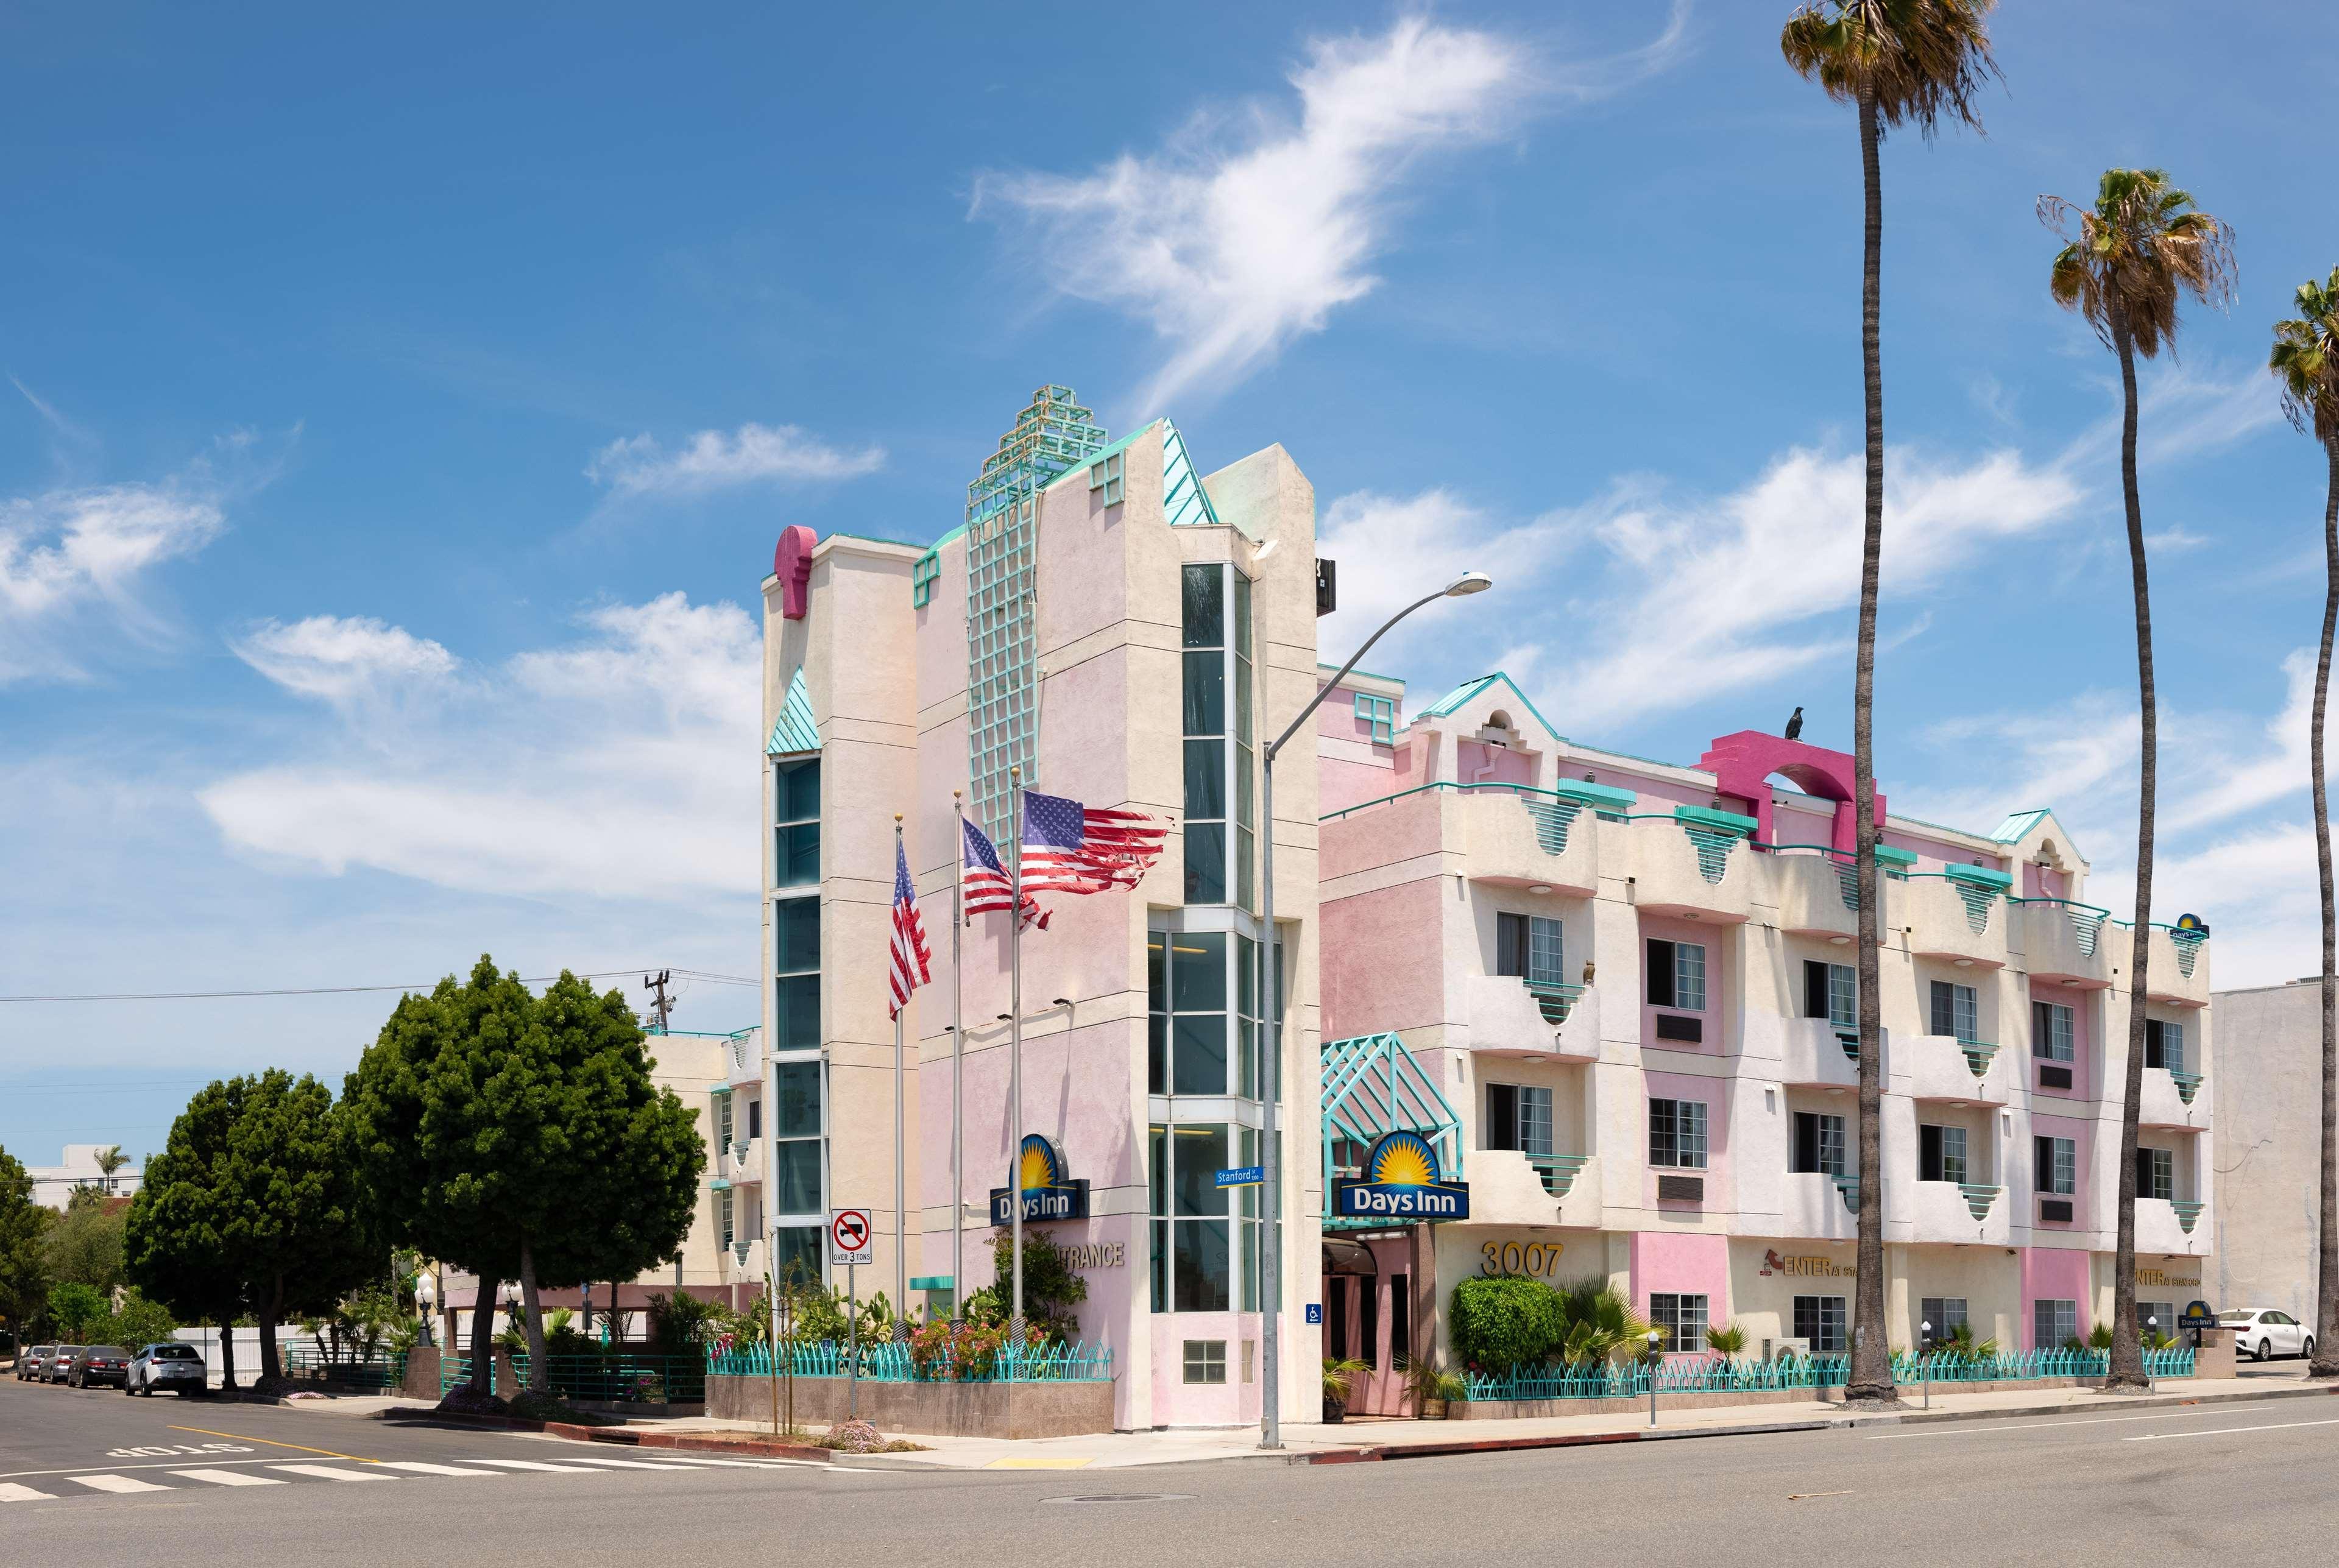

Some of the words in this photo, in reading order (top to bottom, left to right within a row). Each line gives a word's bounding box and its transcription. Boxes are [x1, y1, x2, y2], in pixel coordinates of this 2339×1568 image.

[1219, 1169, 1251, 1182] Stanford
[1000, 1198, 1039, 1220] Dys
[1041, 1193, 1069, 1215] Inn
[1354, 1188, 1414, 1214] Days
[1417, 1190, 1456, 1212] Inn
[849, 1252, 855, 1262] 3
[1481, 1241, 1564, 1277] 3007
[1783, 1257, 1831, 1277] ENTER
[1832, 1266, 1841, 1277] AT
[1843, 1266, 1858, 1277] STA
[2135, 1269, 2164, 1286] NTER
[2164, 1277, 2170, 1286] AT
[2172, 1277, 2201, 1287] STANFORD
[106, 1443, 255, 1457] STOP
